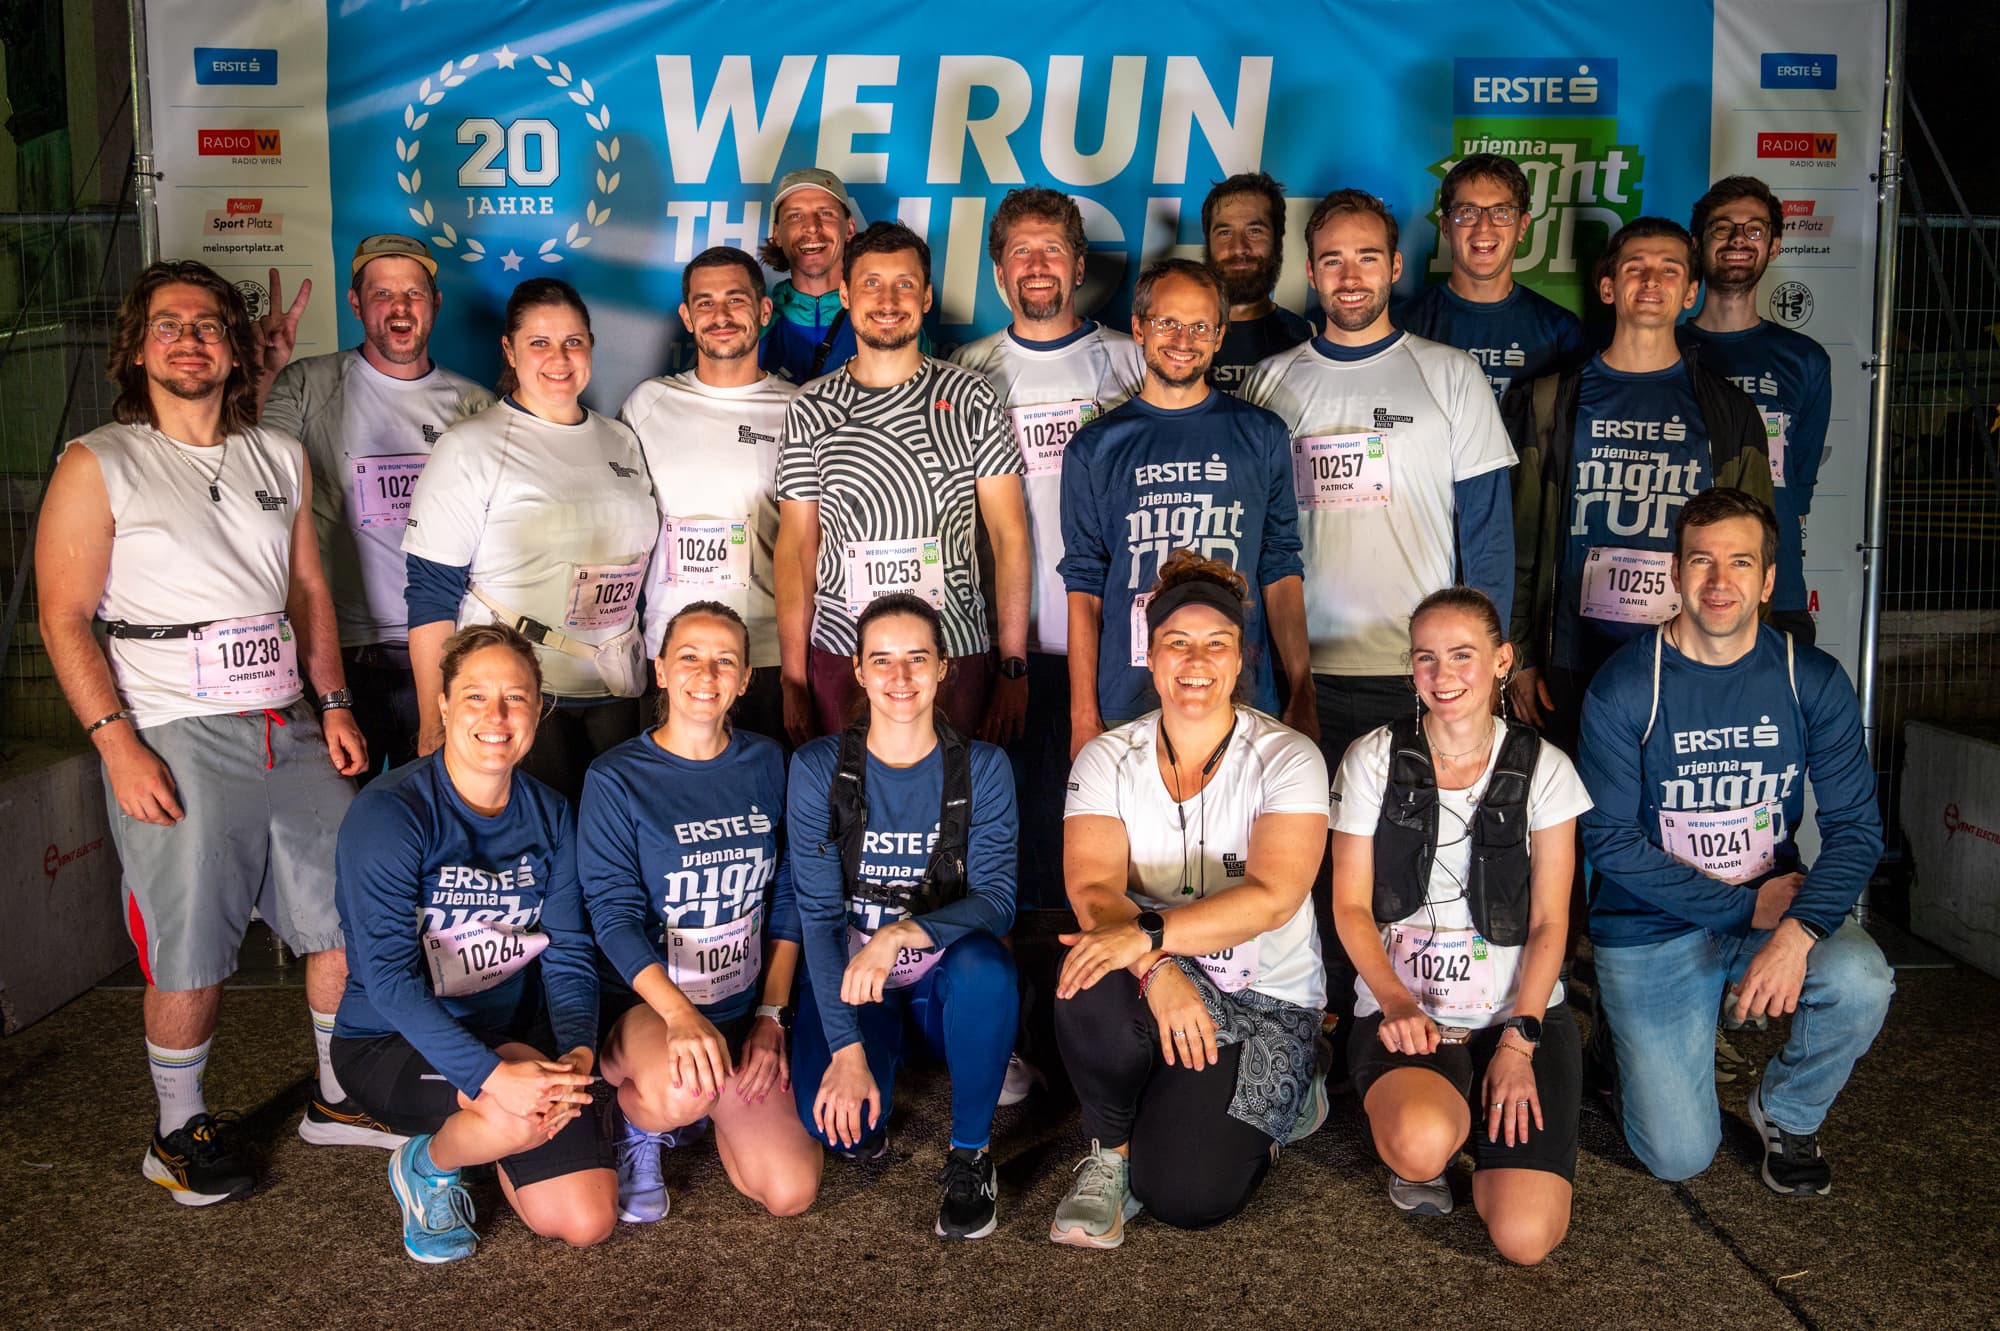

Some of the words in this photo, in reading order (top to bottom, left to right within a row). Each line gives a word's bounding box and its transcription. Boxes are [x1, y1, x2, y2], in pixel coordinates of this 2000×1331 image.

[212, 61, 247, 72] ERSTE
[1777, 66, 1810, 76] ERSTE
[1473, 77, 1564, 104] ERSTE
[655, 54, 900, 185] WE
[926, 54, 1274, 187] RUN
[203, 136, 250, 149] RADIO
[257, 135, 278, 151] W
[1463, 136, 1547, 156] vienna
[1762, 140, 1809, 151] RADIO
[1816, 139, 1835, 153] W
[456, 117, 561, 188] 20
[233, 202, 256, 210] Mein
[466, 196, 554, 219] JAHRE
[1787, 204, 1809, 213] Mein
[213, 218, 245, 231] Sport
[247, 217, 273, 228] Platz
[1798, 220, 1824, 231] Platz
[202, 243, 284, 254] meinsportplatz.at
[1779, 245, 1831, 256] portplatz.at
[1591, 420, 1661, 441] ERSTE
[1039, 449, 1063, 458] RAFAE
[1591, 445, 1649, 461] vienna
[1135, 462, 1202, 487] ERSTE
[1310, 453, 1364, 480] 10257
[1576, 453, 1702, 502] night
[1320, 482, 1354, 492] PATRICK
[1139, 491, 1192, 507] vienna
[1125, 494, 1245, 548] night
[678, 537, 727, 562] 10266
[865, 559, 922, 585] 10253
[1608, 567, 1666, 595] 10255
[1619, 597, 1648, 606] DANIEL
[218, 636, 280, 669] 10238
[229, 669, 276, 682] CHRISTIAN
[1674, 726, 1750, 754] ERSTE
[1677, 760, 1740, 777] vienna
[1660, 761, 1799, 809] night
[674, 815, 749, 844] ERSTE
[1688, 820, 1700, 828] WE
[1700, 820, 1716, 828] RUN
[1722, 817, 1748, 828] NIGHT!
[863, 831, 923, 855] RSTE
[1688, 829, 1751, 858] 10241
[682, 847, 744, 868] vienna
[1704, 859, 1742, 870] MLADEN
[859, 861, 911, 878] ienna
[438, 866, 514, 891] ERSTE
[431, 889, 498, 906] vienna
[454, 932, 467, 942] WE
[467, 928, 485, 939] RUN
[1443, 940, 1467, 949] NIGHT!
[457, 935, 526, 976] 10264
[696, 936, 750, 974] 10248
[481, 970, 503, 982] NINA
[1201, 963, 1227, 974] NDRA
[1411, 953, 1471, 982] 10242
[711, 968, 741, 985] KERSTIN
[1428, 986, 1450, 996] LILLY
